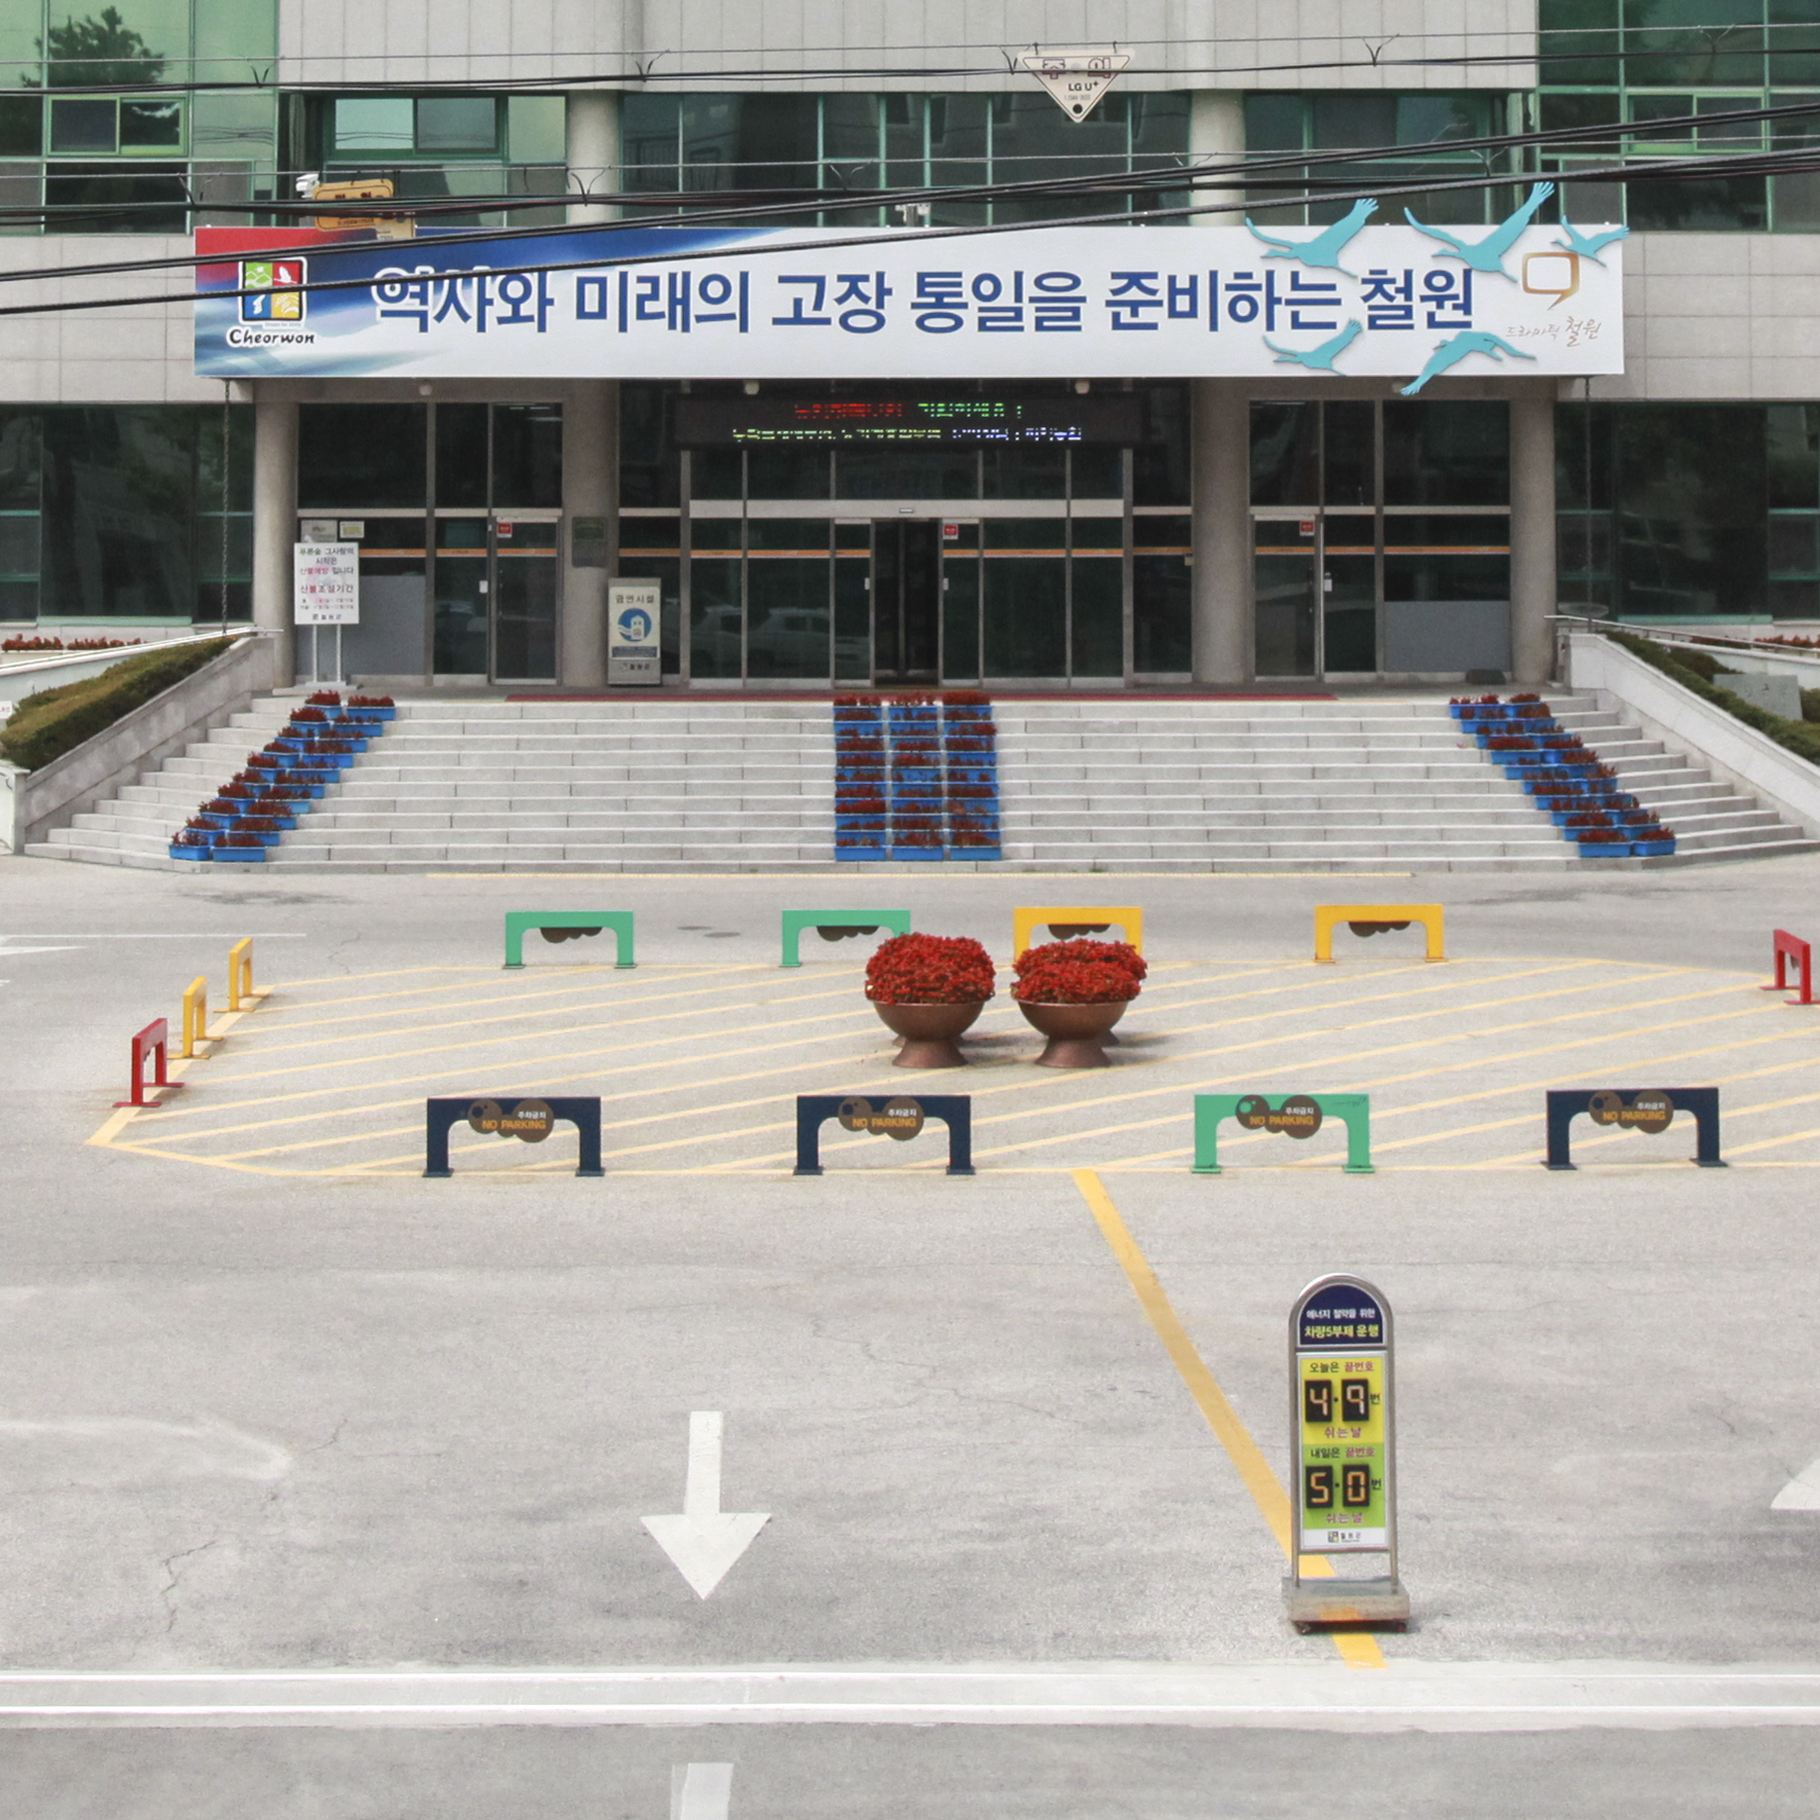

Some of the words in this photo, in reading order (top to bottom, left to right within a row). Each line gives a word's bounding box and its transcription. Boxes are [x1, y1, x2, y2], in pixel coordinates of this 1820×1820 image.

[1068, 83, 1082, 92] LG
[377, 268, 555, 333] 역사와
[575, 270, 749, 332] 미래의
[774, 271, 892, 332] 고장
[912, 271, 1086, 332] 통일을
[1107, 270, 1341, 331] 준비하는
[1363, 269, 1472, 330] 철원
[229, 328, 316, 346] Cheorwon
[1565, 315, 1602, 348] 철원
[1249, 1116, 1266, 1126] NO
[1269, 1115, 1315, 1126] PARKING
[1602, 1111, 1619, 1121] NO
[1621, 1110, 1667, 1121] PARKING
[481, 1119, 499, 1130] NO
[501, 1119, 547, 1130] PARKING
[852, 1118, 869, 1128] NO
[871, 1117, 917, 1128] PARKING
[1306, 1308, 1331, 1319] 에너지
[1359, 1308, 1376, 1319] 위한
[1304, 1324, 1354, 1339] 차량5부제
[1356, 1324, 1380, 1338] 운행
[1309, 1361, 1339, 1373] 오늘은
[1310, 1447, 1340, 1459] 내일은
